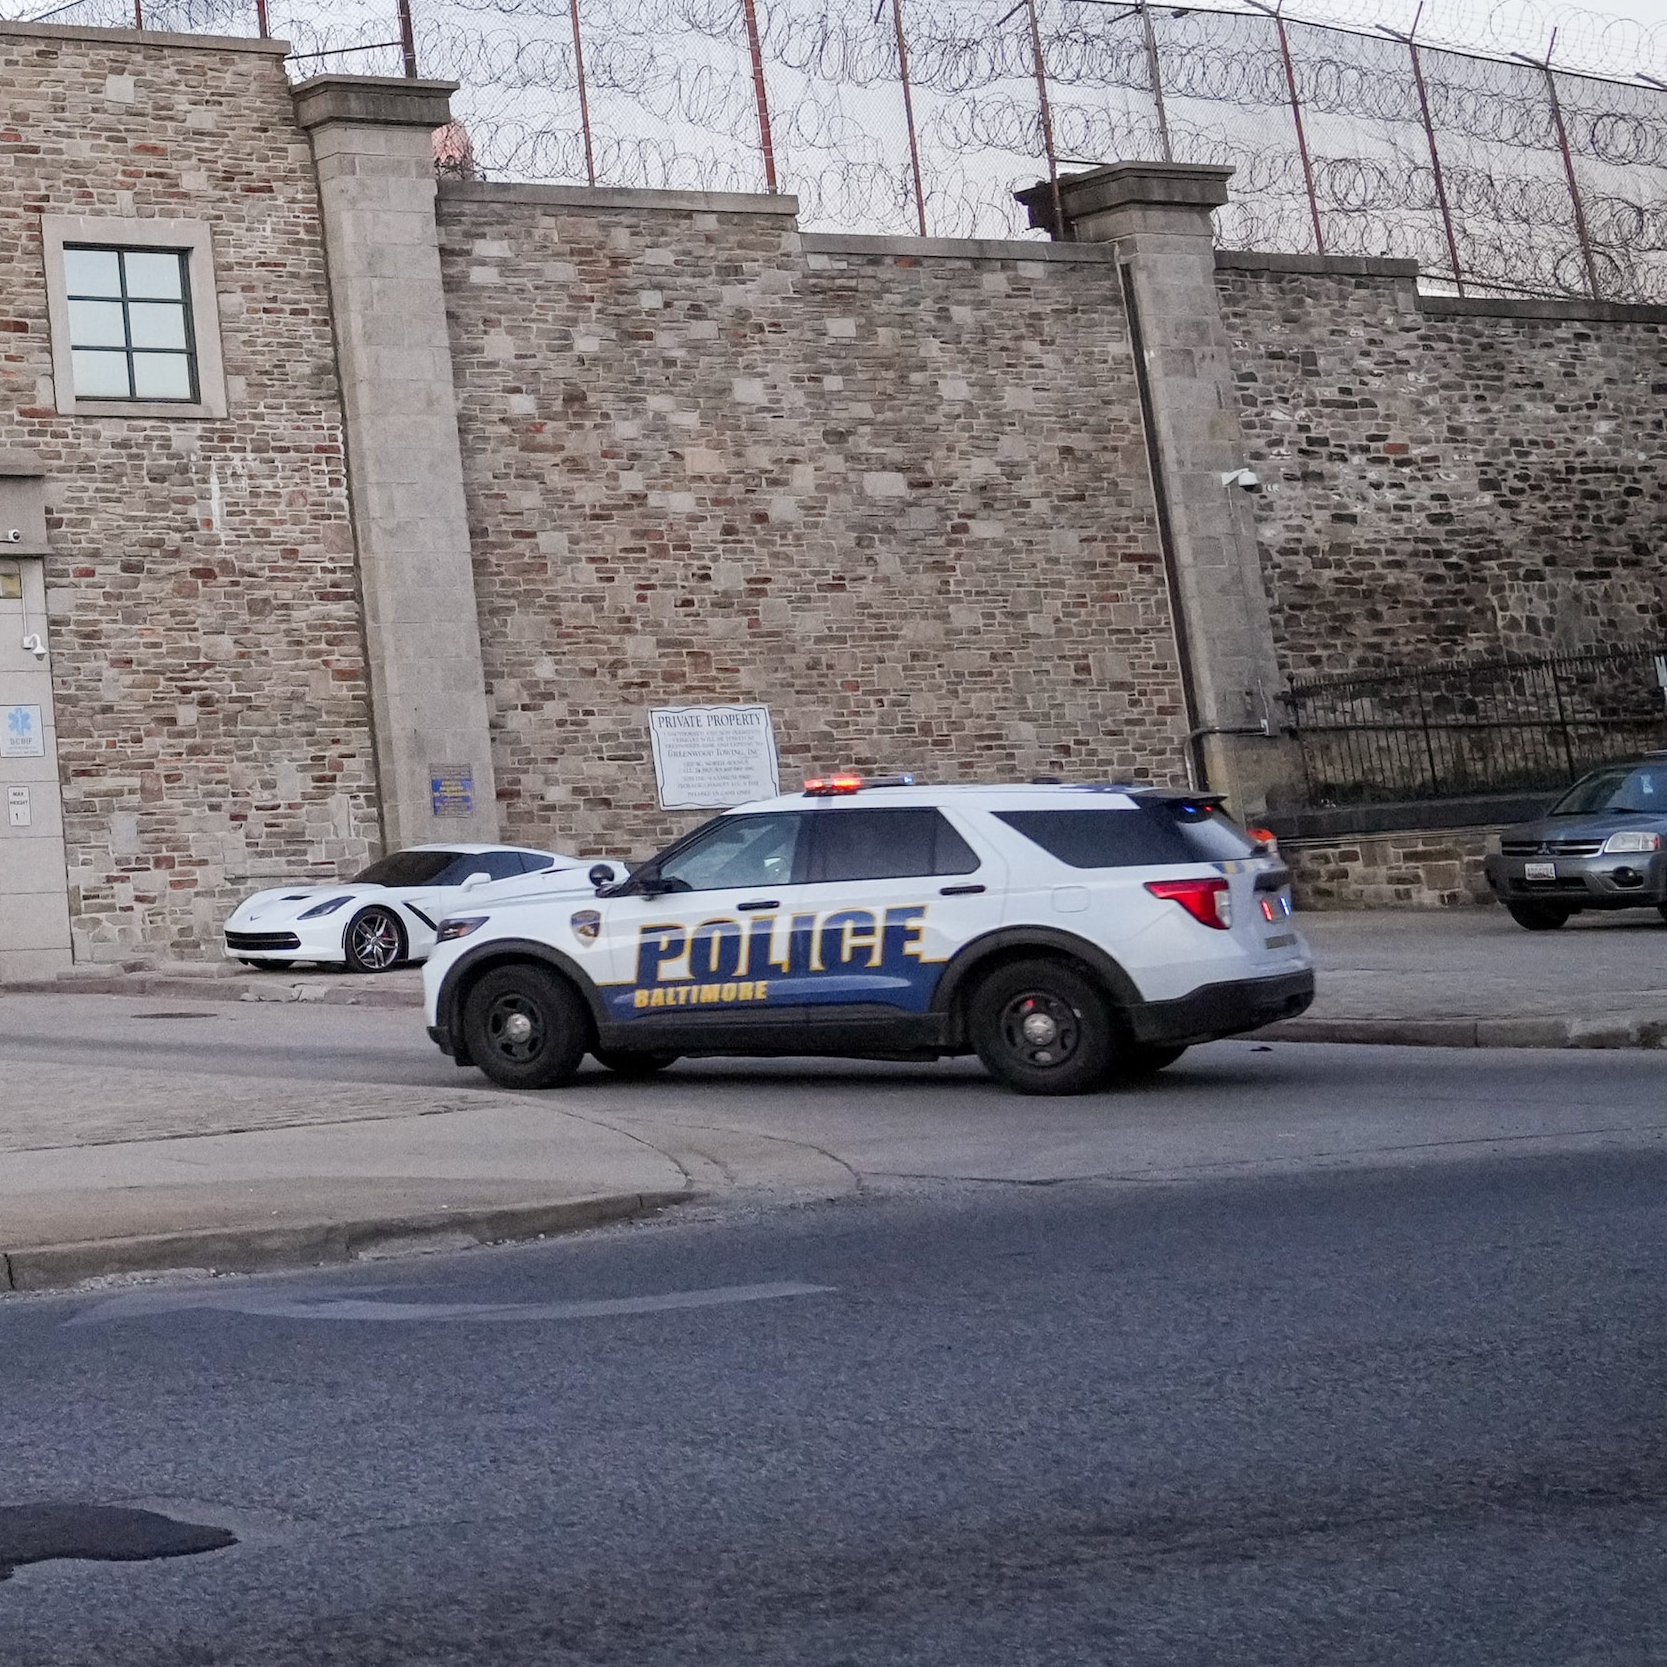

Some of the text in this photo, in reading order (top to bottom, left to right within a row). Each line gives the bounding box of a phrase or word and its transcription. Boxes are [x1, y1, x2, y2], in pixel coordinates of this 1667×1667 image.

[657, 713, 761, 728] PRIVATE PROPERTY
[635, 904, 949, 984] POLICE
[634, 980, 768, 1009] BALTIMORE
